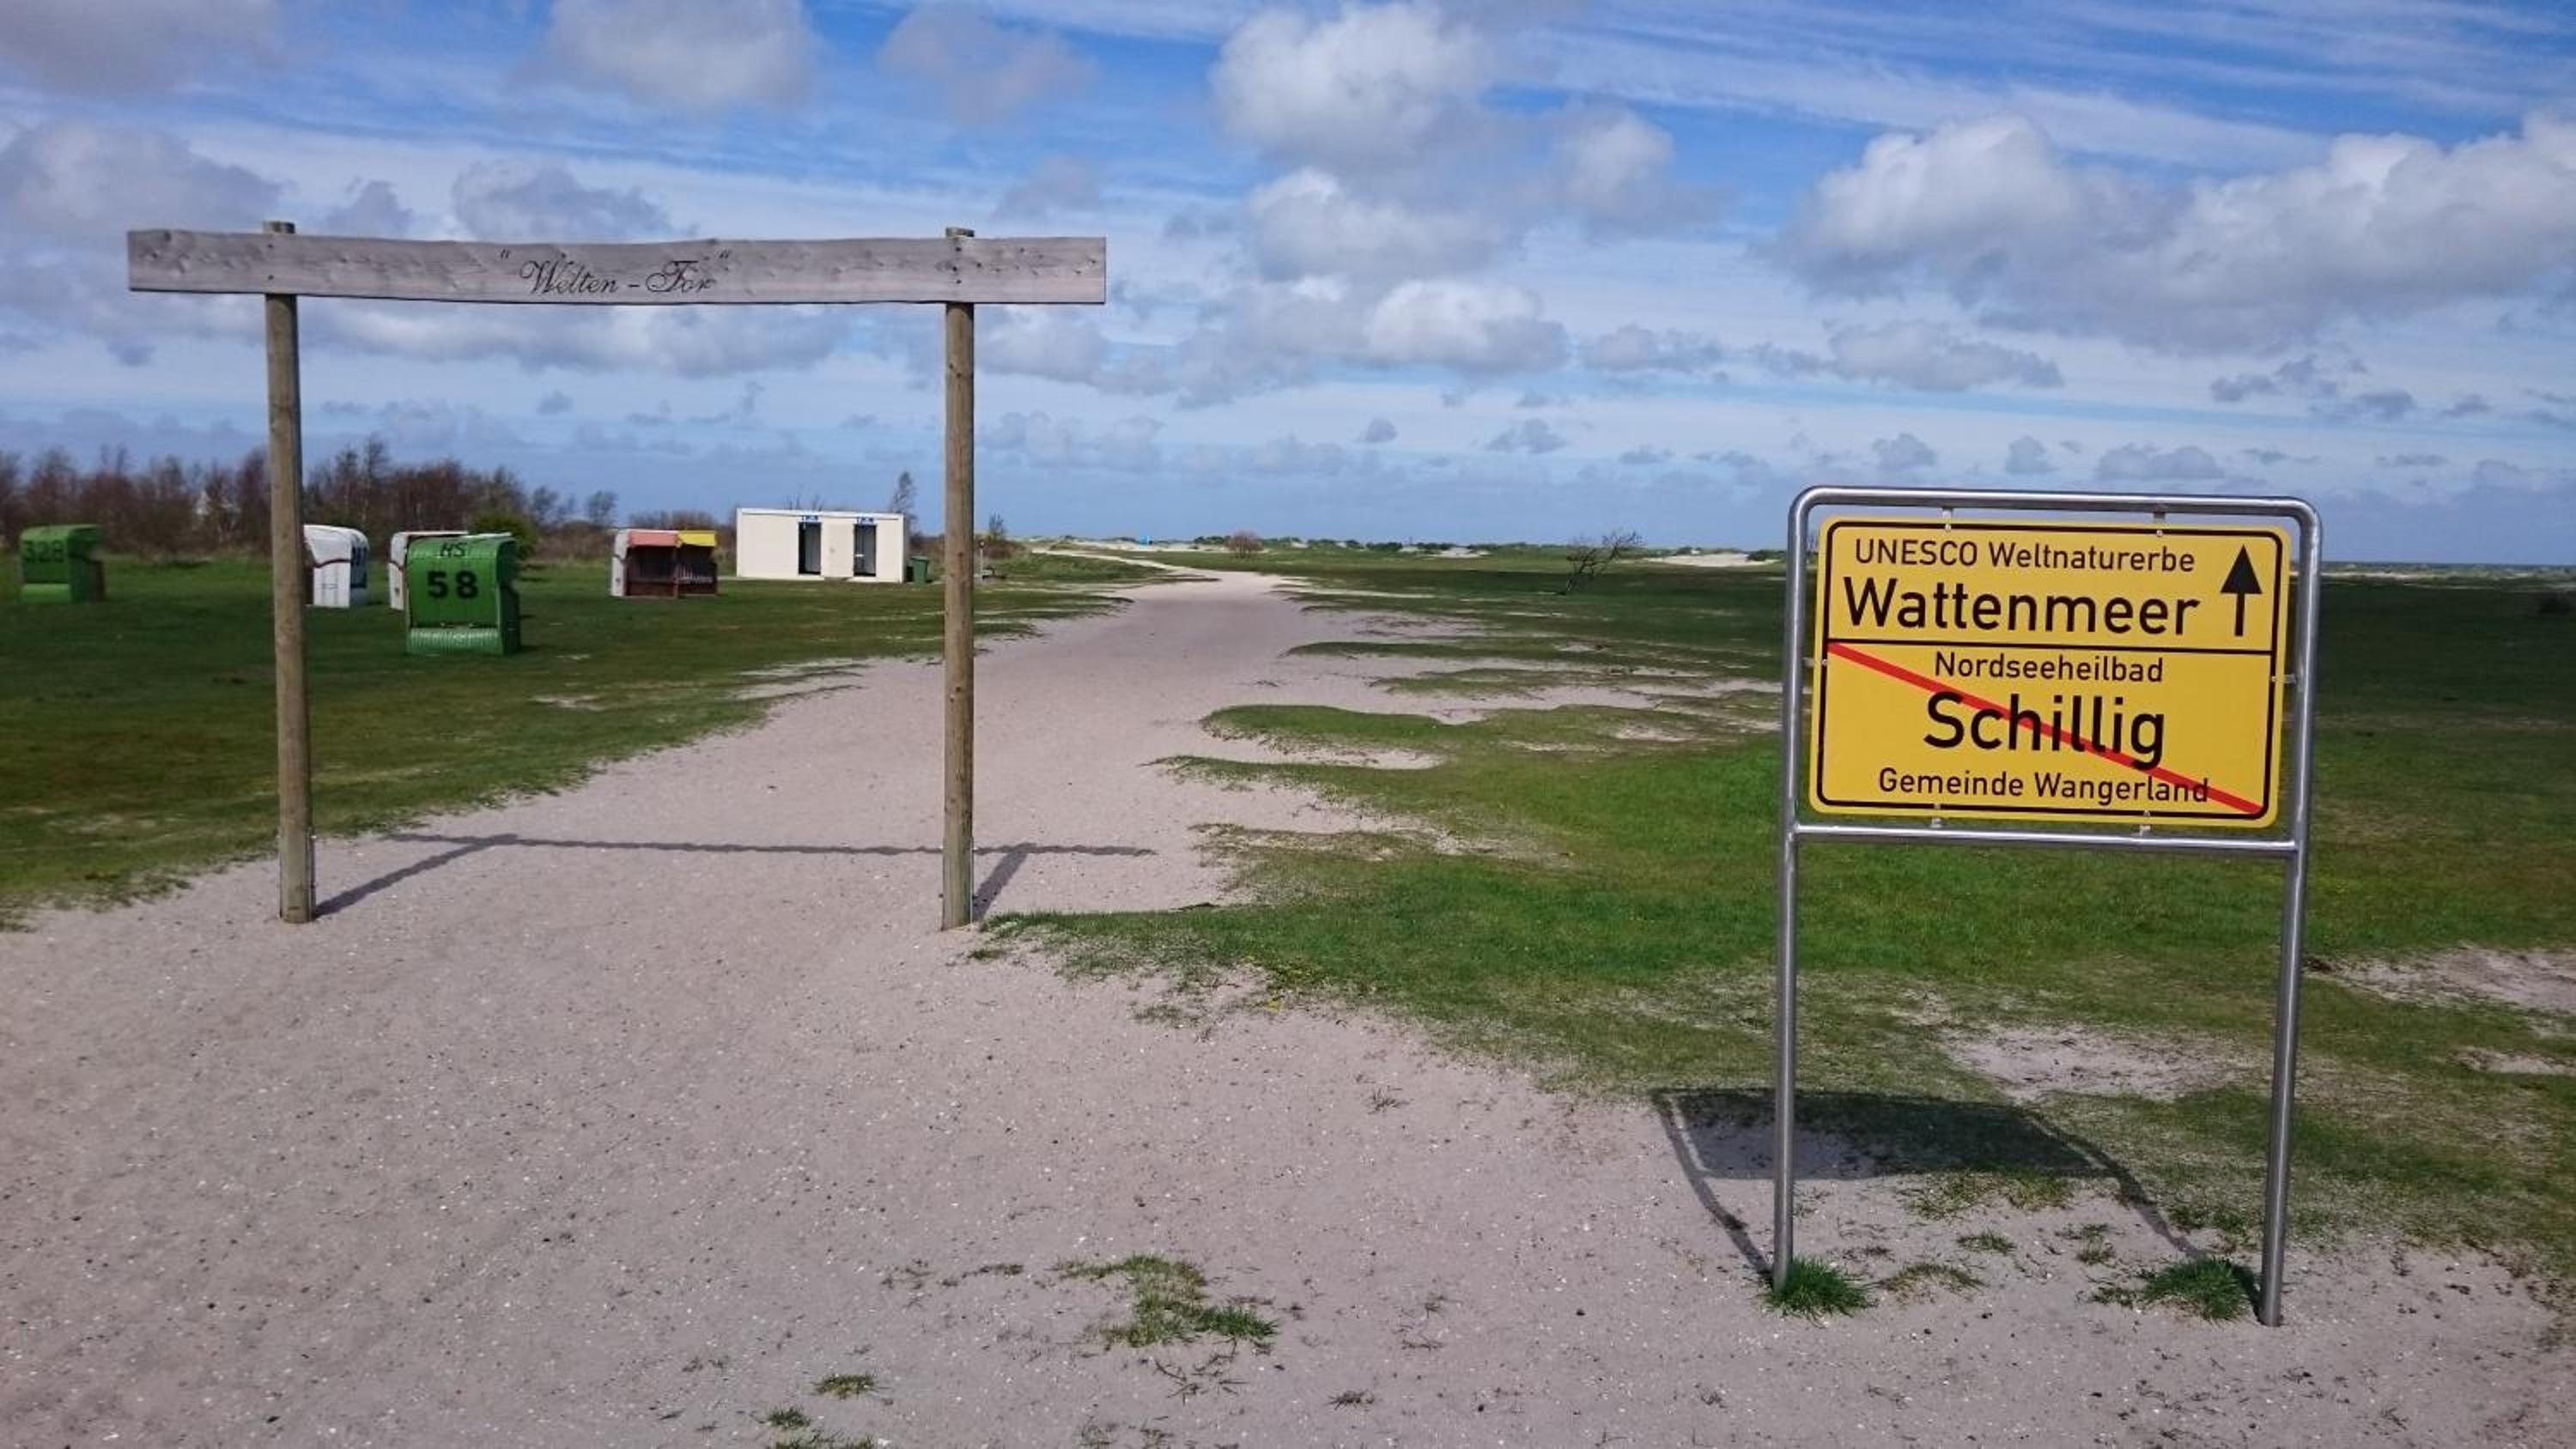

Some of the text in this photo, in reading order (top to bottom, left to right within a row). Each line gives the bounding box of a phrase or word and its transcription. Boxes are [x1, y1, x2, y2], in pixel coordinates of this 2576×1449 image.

[1855, 539, 2196, 572] UNESCO Weltnaturerbe
[428, 569, 478, 599] 58
[1844, 576, 2200, 636] Wattenmeer
[1935, 651, 2163, 683] Nordseeheilbad
[1923, 691, 2165, 771] Schillig
[1879, 767, 2209, 803] Gemeinde Wangerland
